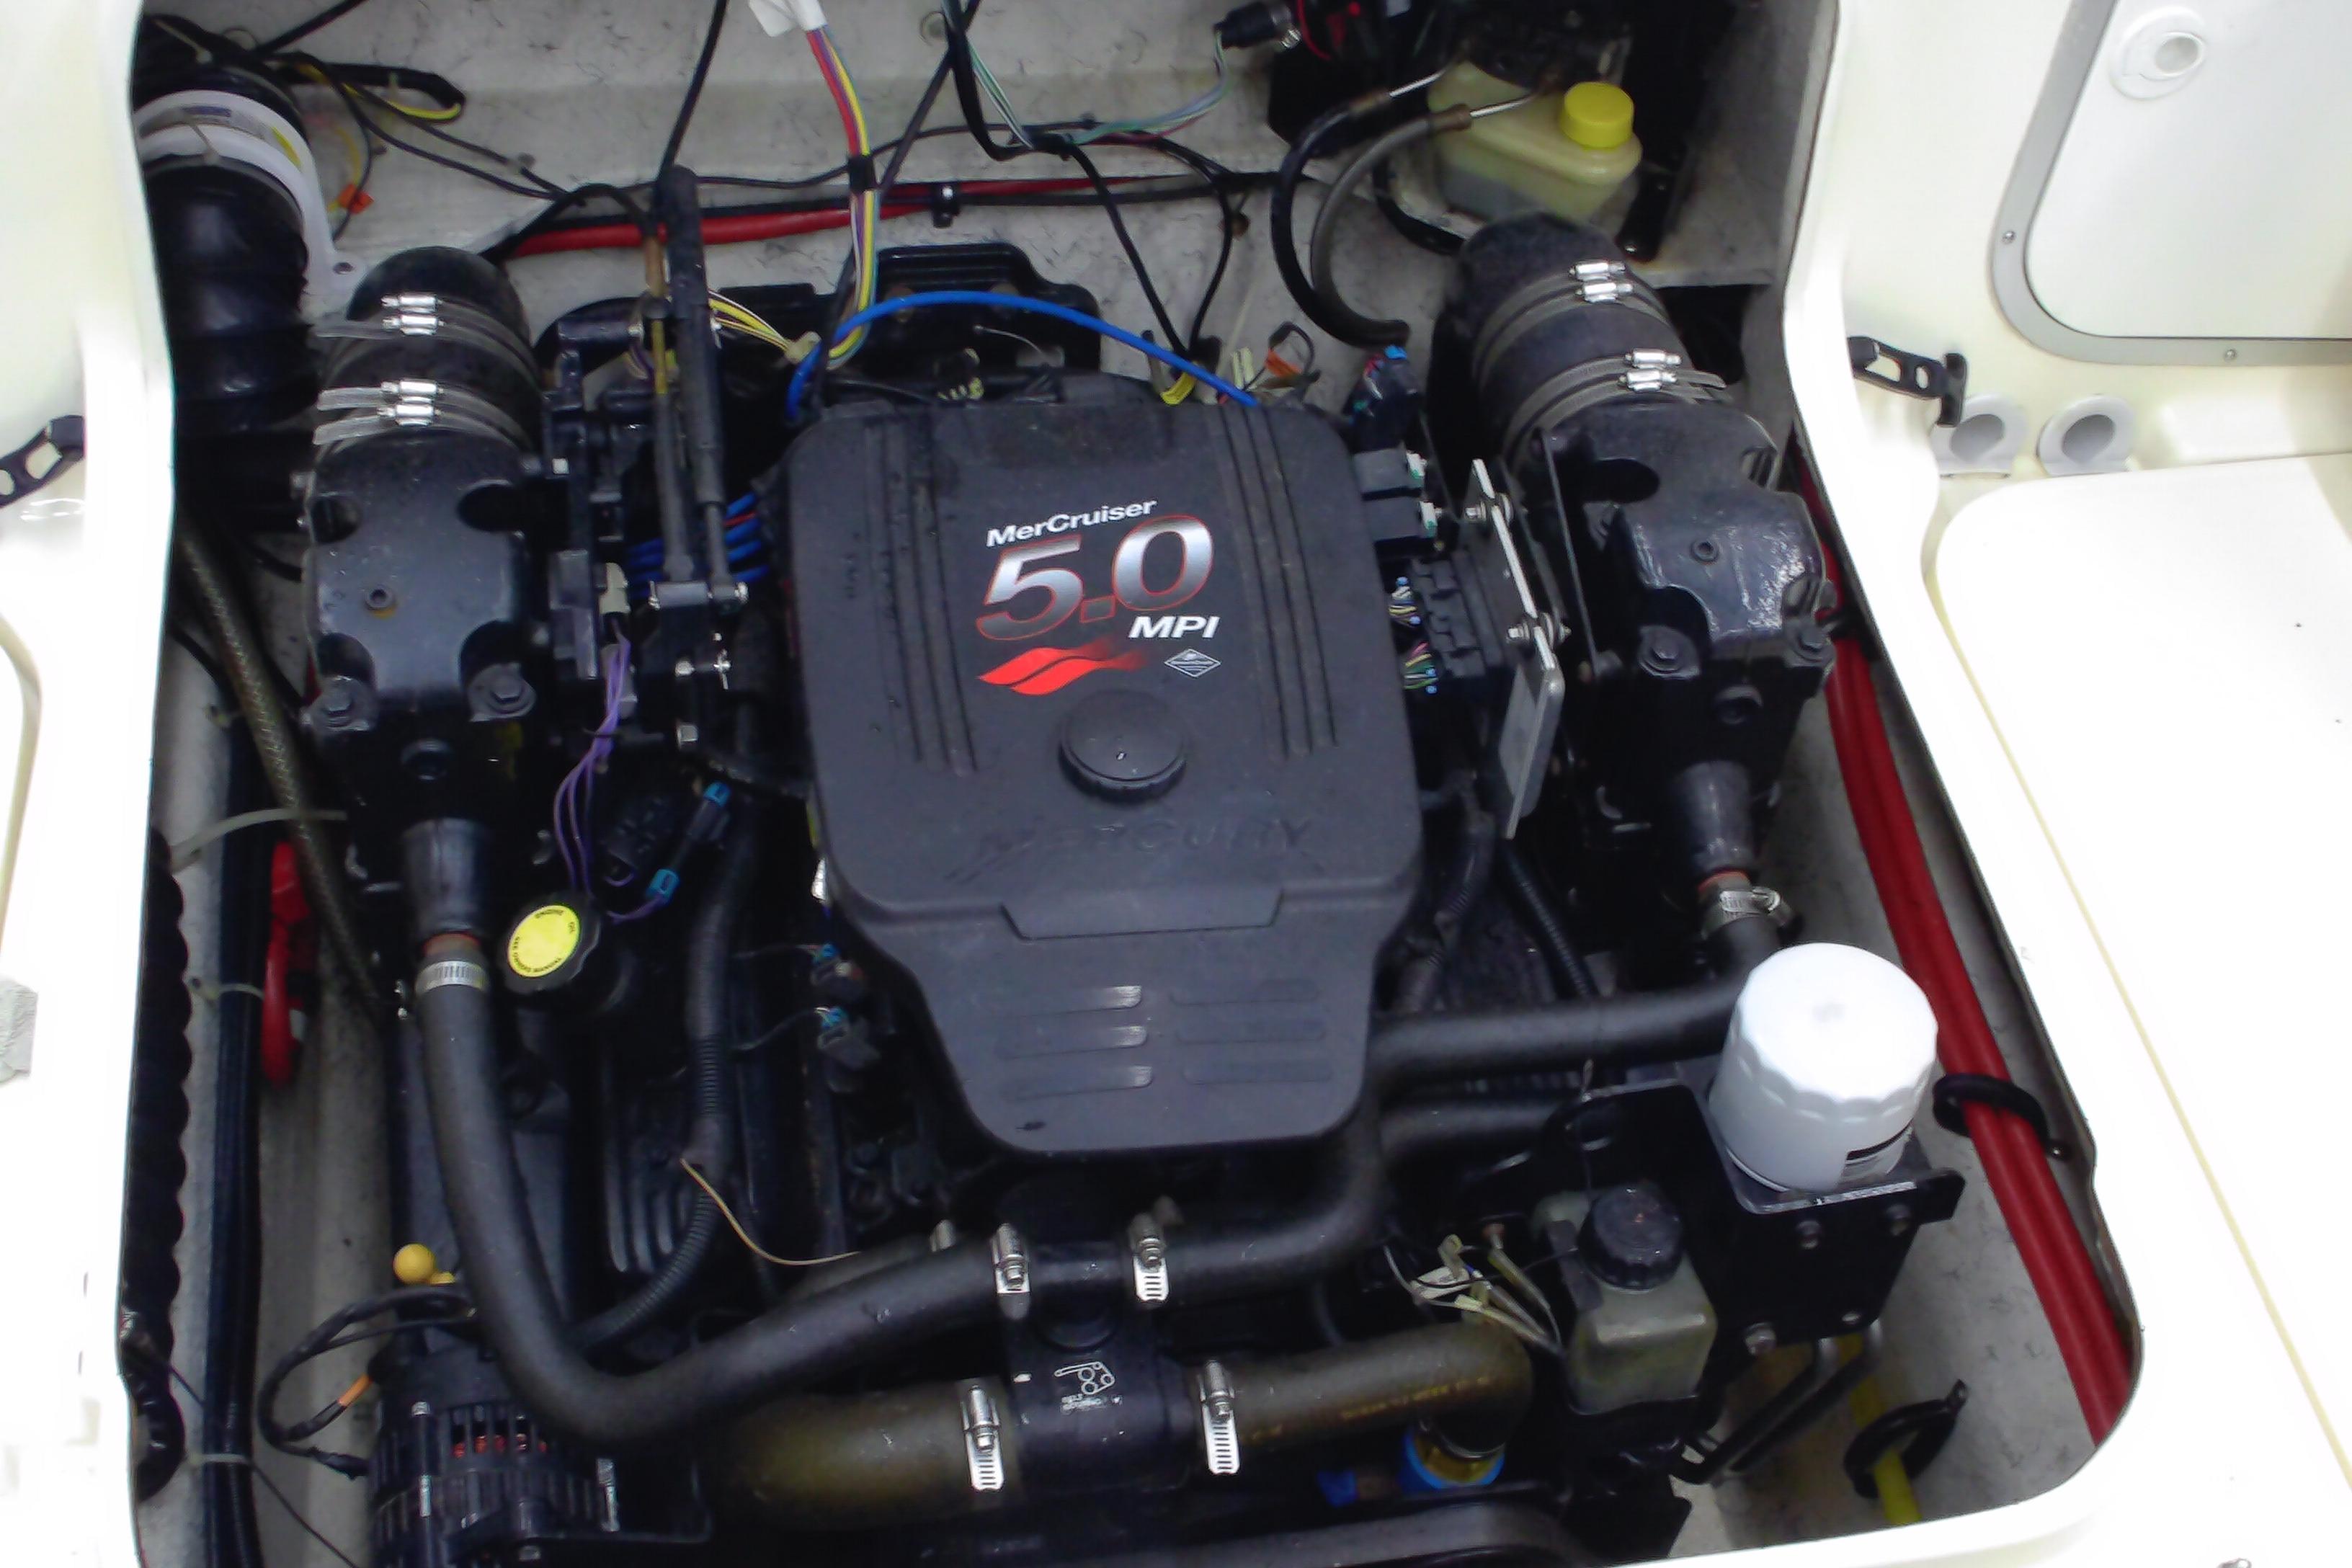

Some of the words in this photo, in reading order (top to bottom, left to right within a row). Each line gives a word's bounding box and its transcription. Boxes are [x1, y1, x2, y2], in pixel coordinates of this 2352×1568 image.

[986, 500, 1157, 548] MerCruiser
[976, 514, 1214, 641] 5.0
[1128, 616, 1221, 639] MPI
